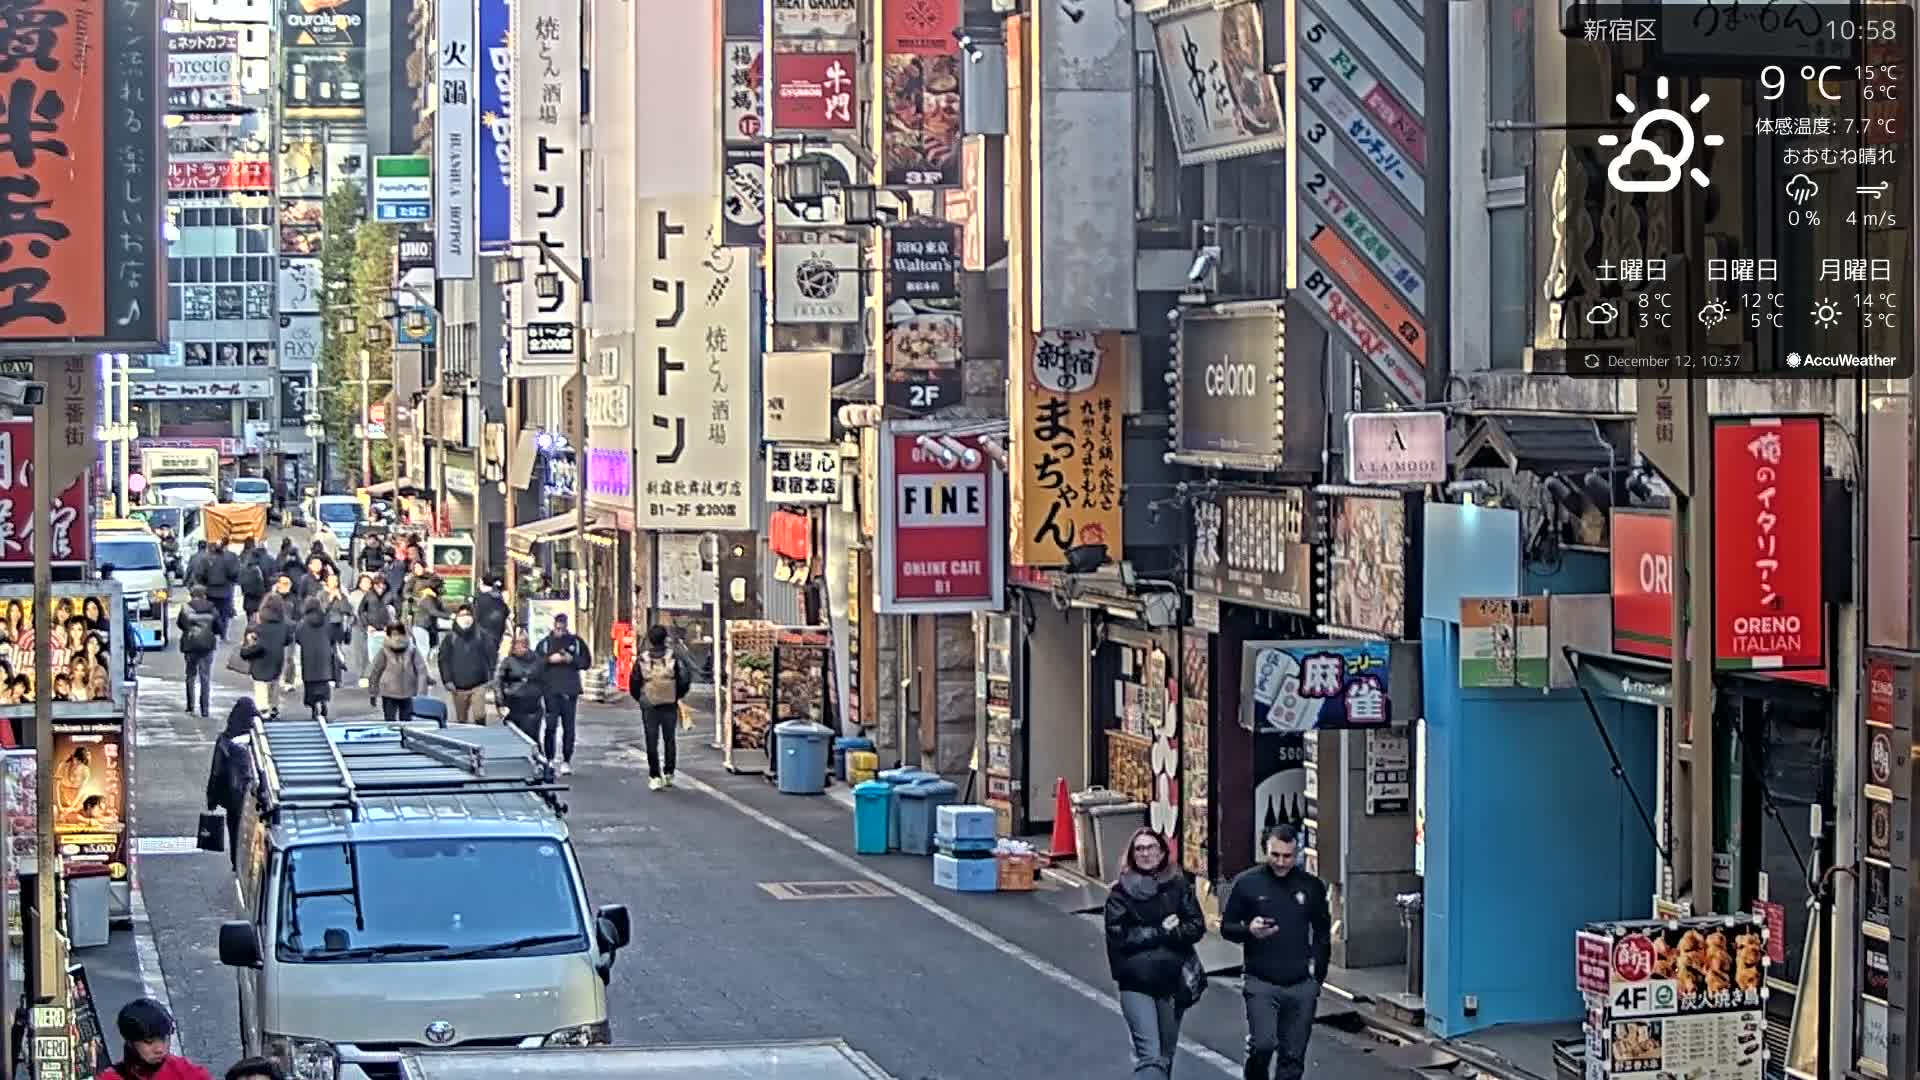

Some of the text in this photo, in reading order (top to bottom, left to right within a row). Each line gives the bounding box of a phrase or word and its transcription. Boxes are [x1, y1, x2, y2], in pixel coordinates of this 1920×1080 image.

[1307, 24, 1327, 43] 5
[823, 60, 852, 122] 牛門
[1307, 76, 1326, 92] 4
[1307, 124, 1327, 144] 3
[379, 184, 428, 192] FamilyMart
[1307, 173, 1327, 194] 2
[1310, 223, 1326, 242] 1
[894, 257, 951, 273] Walton's
[1305, 270, 1332, 300] B1
[652, 210, 685, 464] トントン
[1205, 353, 1256, 397] celona
[706, 326, 730, 446] 焼とん酒場
[910, 386, 939, 406] 2F
[1034, 397, 1079, 550] まっちゃん
[904, 486, 979, 515] FINE
[1748, 431, 1782, 604] 俺のイタリアン
[903, 561, 947, 577] ONLINE
[1734, 617, 1800, 633] ORENO
[1734, 635, 1801, 653] ITALIAN
[1303, 654, 1385, 722] 麻雀
[1615, 987, 1648, 1010] 4F
[1680, 988, 1760, 1010] 炭火焼き鳥
[37, 1039, 67, 1057] NERO
